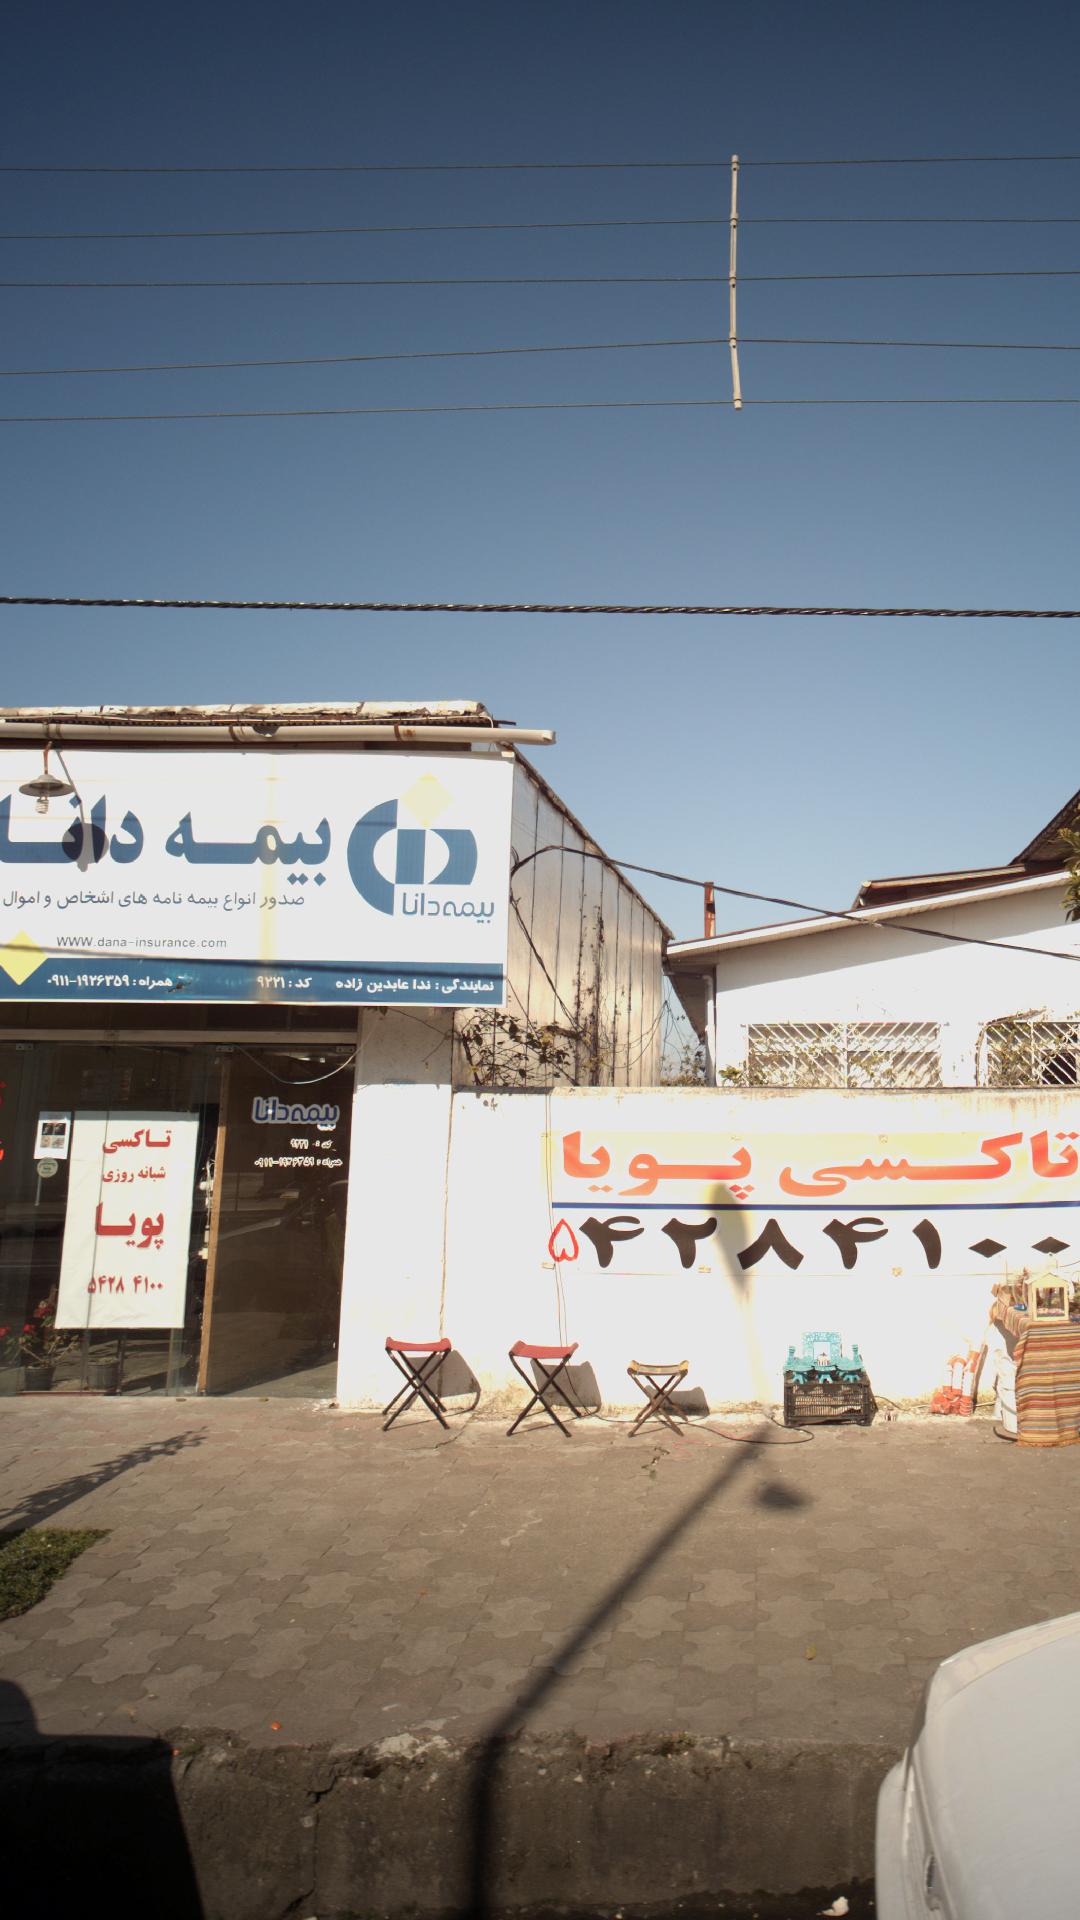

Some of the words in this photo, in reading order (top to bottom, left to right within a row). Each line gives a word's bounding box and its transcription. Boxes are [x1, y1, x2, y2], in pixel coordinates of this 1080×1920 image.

[0, 794, 144, 864] دانا
[165, 811, 331, 887] بیمه
[57, 891, 114, 909] اشخاص
[118, 891, 147, 907] های
[153, 892, 182, 905] نامه
[187, 895, 218, 909] بیمه
[223, 891, 256, 911] انواع
[260, 895, 305, 910] صدور
[256, 975, 285, 989] ۹۲۲۱
[335, 978, 363, 991] زاده
[367, 979, 409, 993] عابدین
[413, 979, 431, 990] ندا
[102, 1129, 172, 1154] تاکسی
[562, 1131, 755, 1200] پویا
[778, 1130, 1080, 1198] تاکسی
[102, 1167, 135, 1183] روزی
[137, 1166, 166, 1182] شبانه
[95, 1202, 165, 1250] پویا
[133, 1275, 164, 1294] ۴۱۰۰
